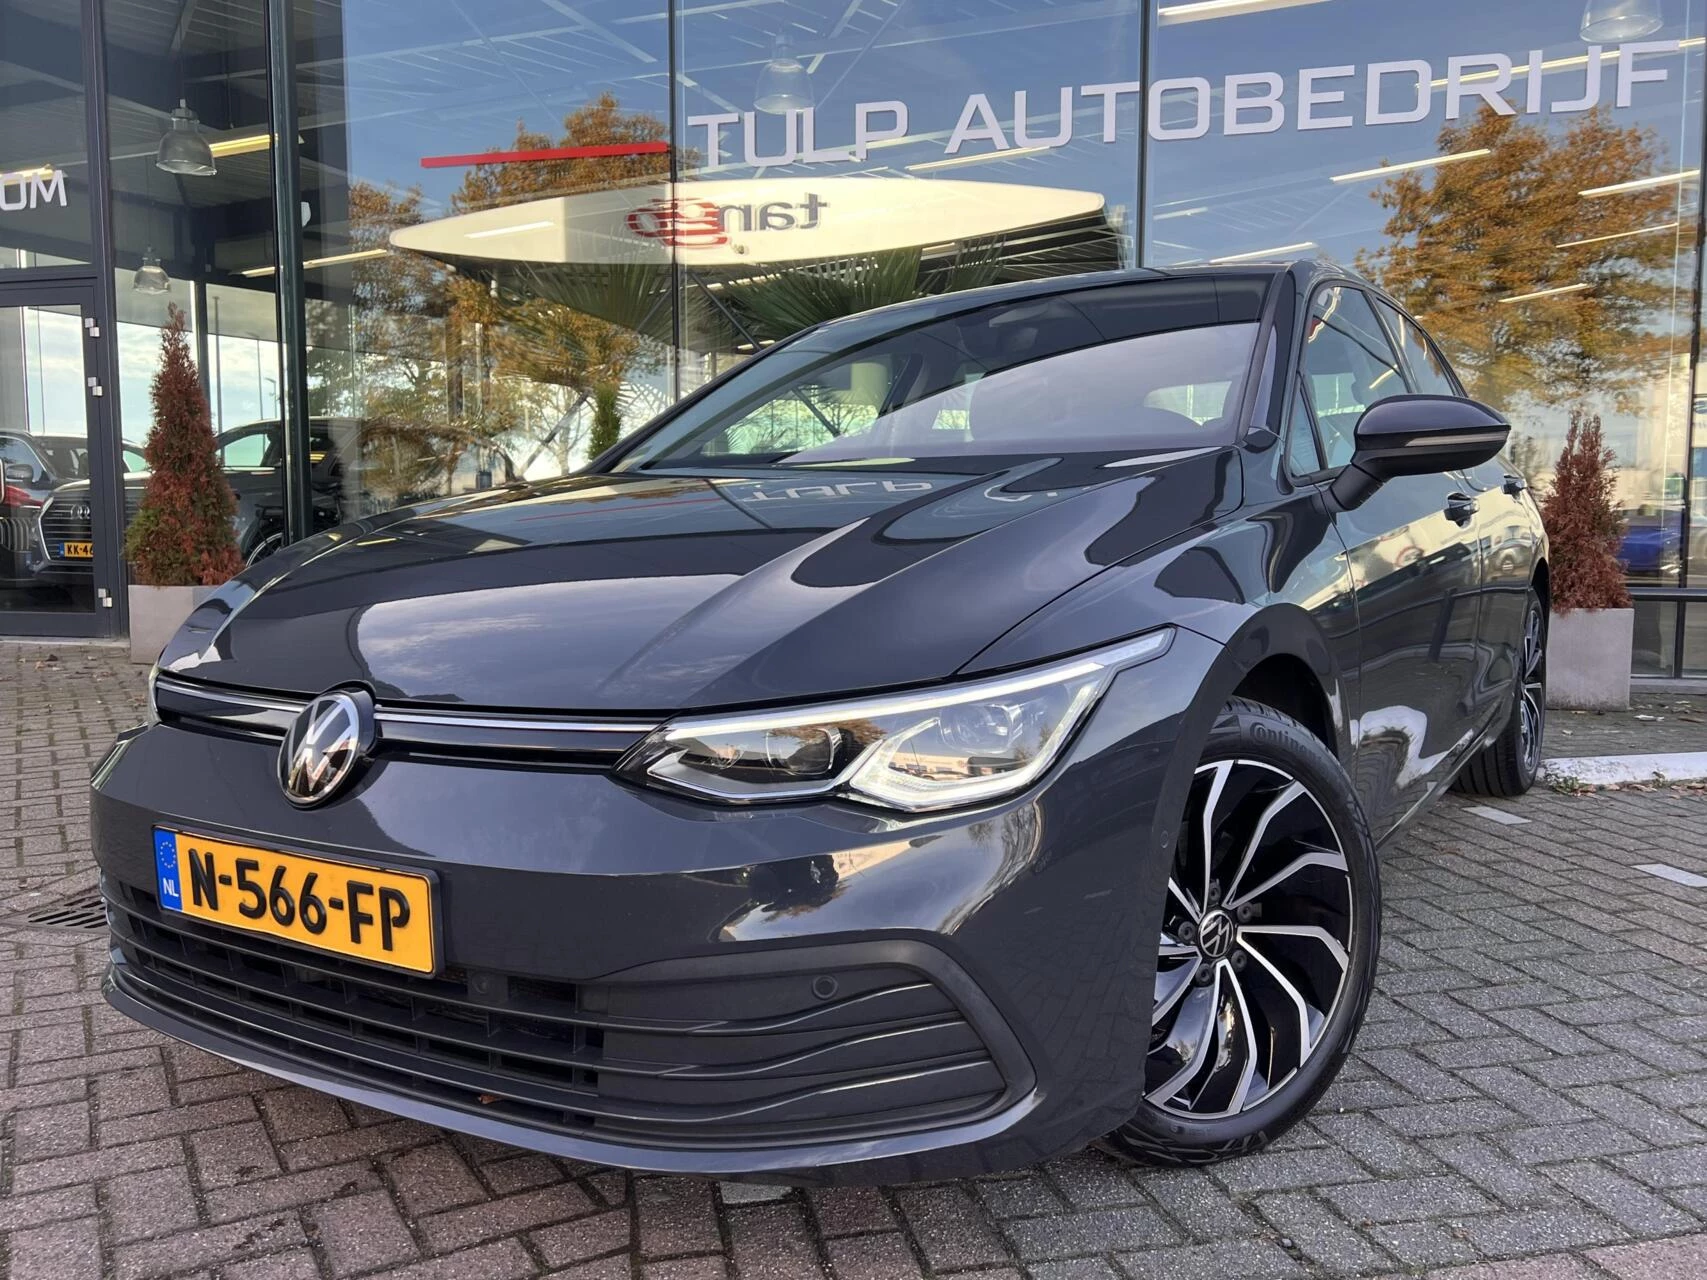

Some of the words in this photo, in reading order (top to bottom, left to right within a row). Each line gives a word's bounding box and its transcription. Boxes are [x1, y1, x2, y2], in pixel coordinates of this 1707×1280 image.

[687, 100, 908, 171] TULP
[944, 40, 1680, 154] AUTOBEDRIJF
[163, 877, 180, 898] NL
[188, 848, 411, 952] N-566-FP
